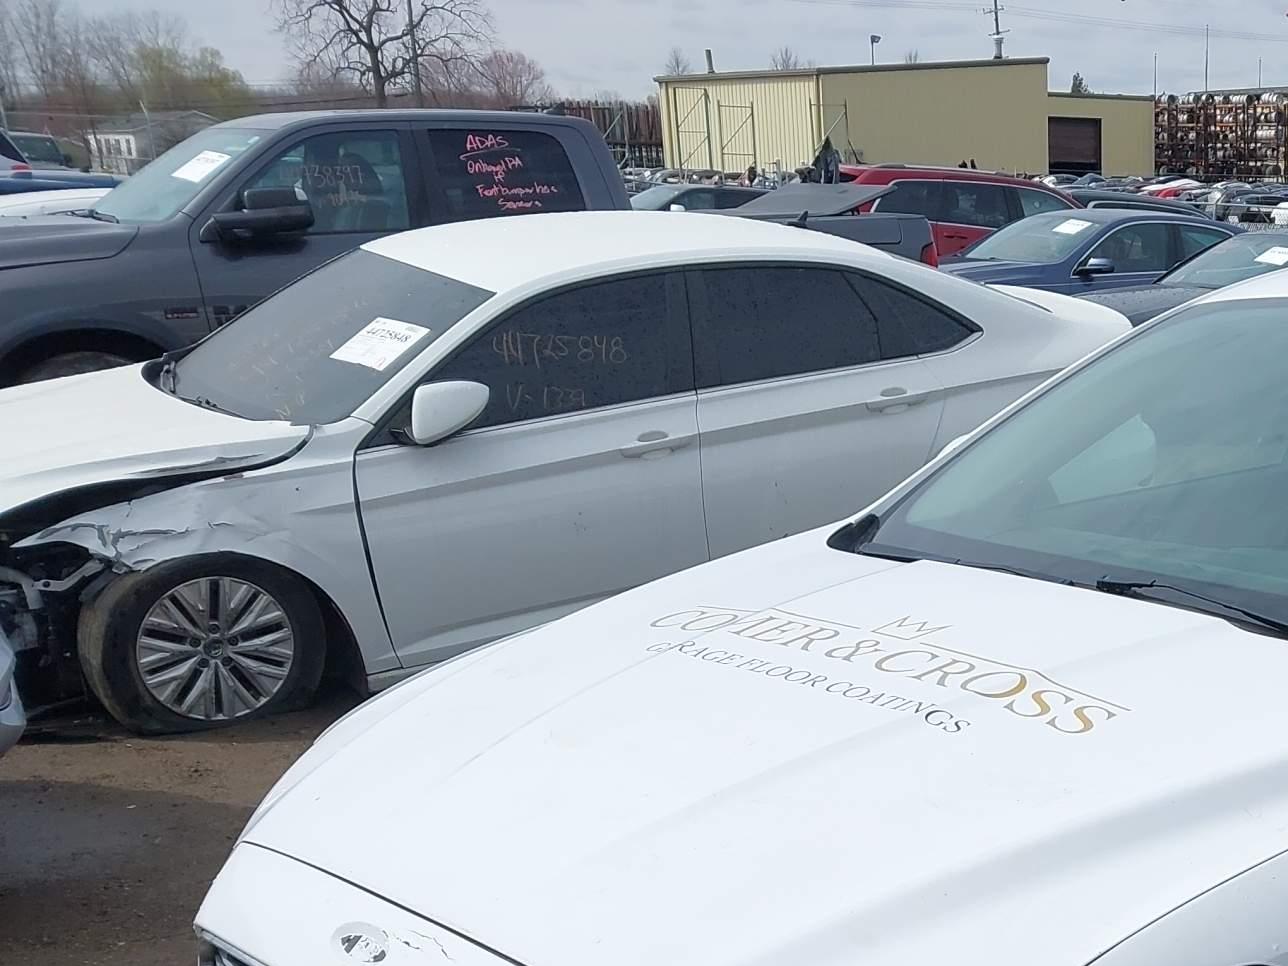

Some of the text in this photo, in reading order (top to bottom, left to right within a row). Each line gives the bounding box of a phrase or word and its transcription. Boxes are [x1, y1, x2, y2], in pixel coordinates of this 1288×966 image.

[466, 134, 509, 151] ADAS
[735, 657, 829, 688] FLOOR
[825, 681, 972, 734] COATINGS
[824, 639, 887, 663] &
[874, 649, 1118, 735] CROSS
